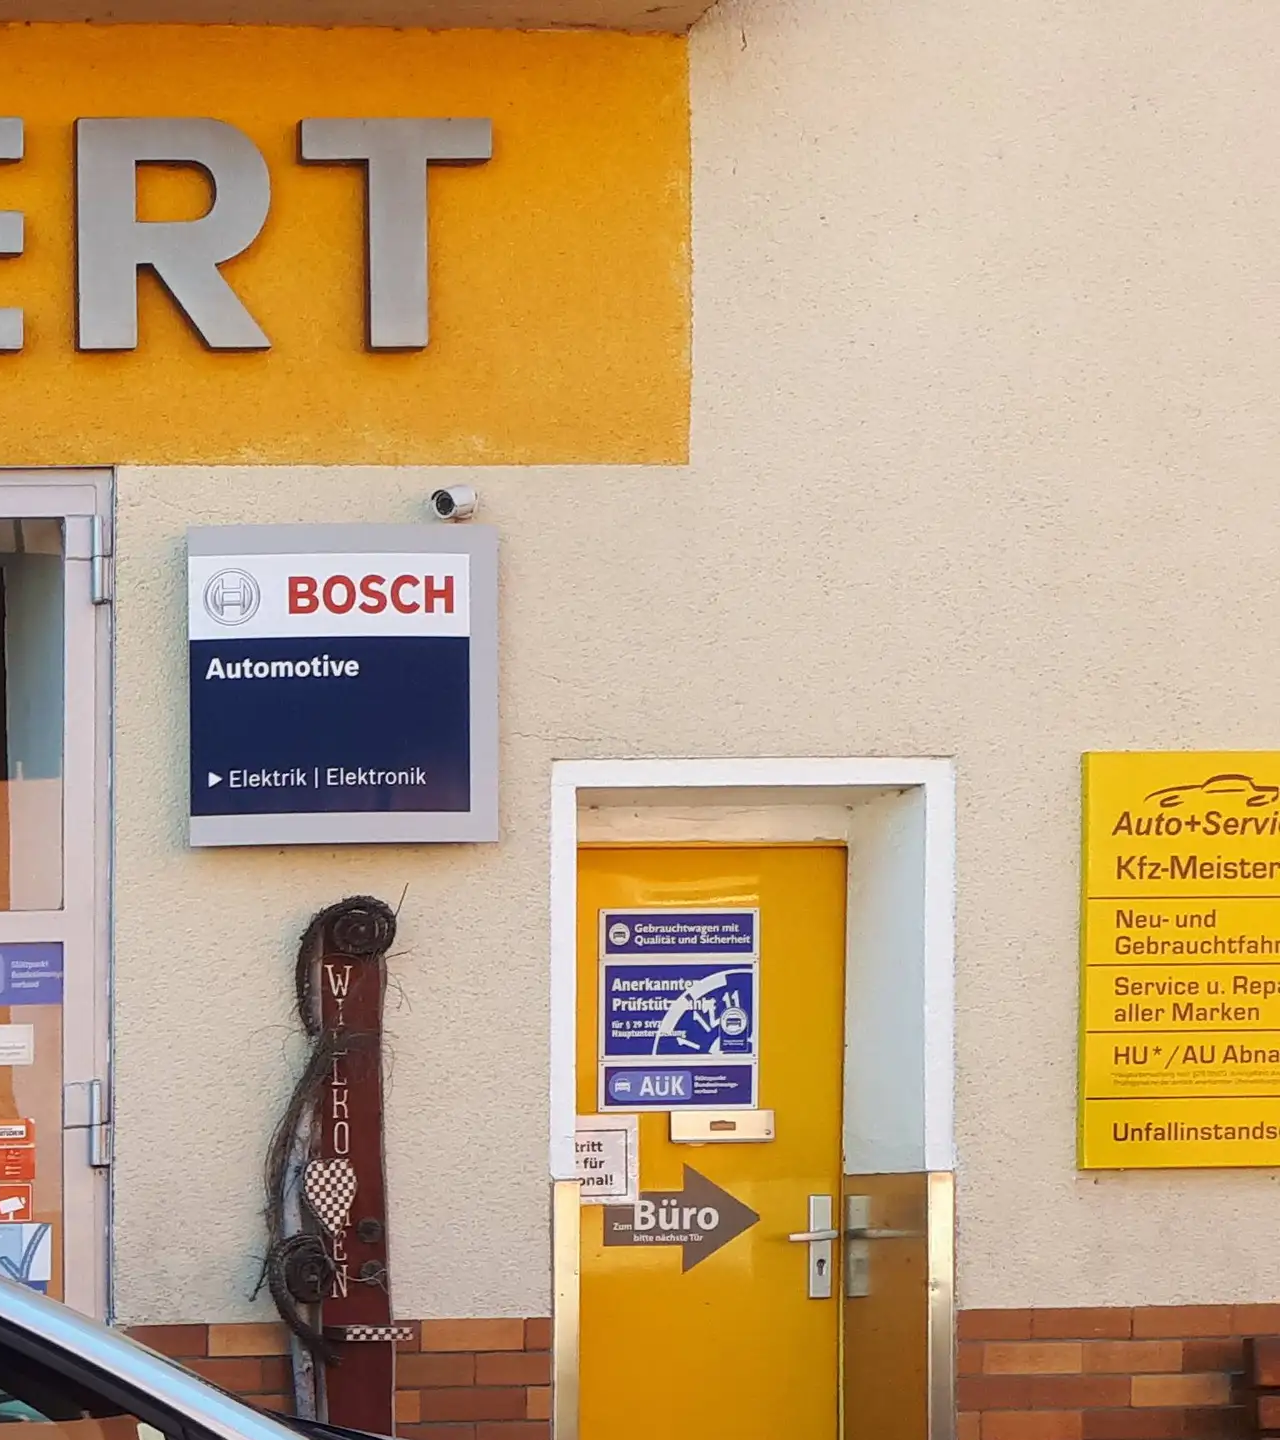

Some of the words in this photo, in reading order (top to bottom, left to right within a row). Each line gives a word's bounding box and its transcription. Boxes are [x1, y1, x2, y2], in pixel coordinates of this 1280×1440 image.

[288, 574, 454, 615] BOSCH
[205, 654, 360, 680] Automotive
[229, 768, 307, 788] Elektrik
[326, 767, 427, 787] Elektronik
[1112, 810, 1280, 836] Auto+Servi
[634, 924, 719, 934] Gebrauchtwagen
[722, 923, 739, 932] mit
[1116, 909, 1169, 929] Neu-
[1176, 909, 1216, 928] und
[634, 935, 676, 945] Qualität
[678, 935, 698, 944] und
[700, 934, 751, 944] Sicherheit
[1114, 976, 1199, 996] Service
[1207, 981, 1225, 995] u.
[1114, 1003, 1165, 1022] aller
[1172, 1002, 1260, 1022] Marken
[633, 1020, 643, 1028] 29
[640, 1076, 685, 1096] AÜK
[1113, 1122, 1280, 1142] Unfallinstands
[583, 1157, 605, 1169] für
[613, 1223, 632, 1231] Zum
[634, 1200, 719, 1231] Büro
[634, 1234, 654, 1242] bitte
[655, 1234, 688, 1242] nächste
[689, 1233, 704, 1242] Tür
